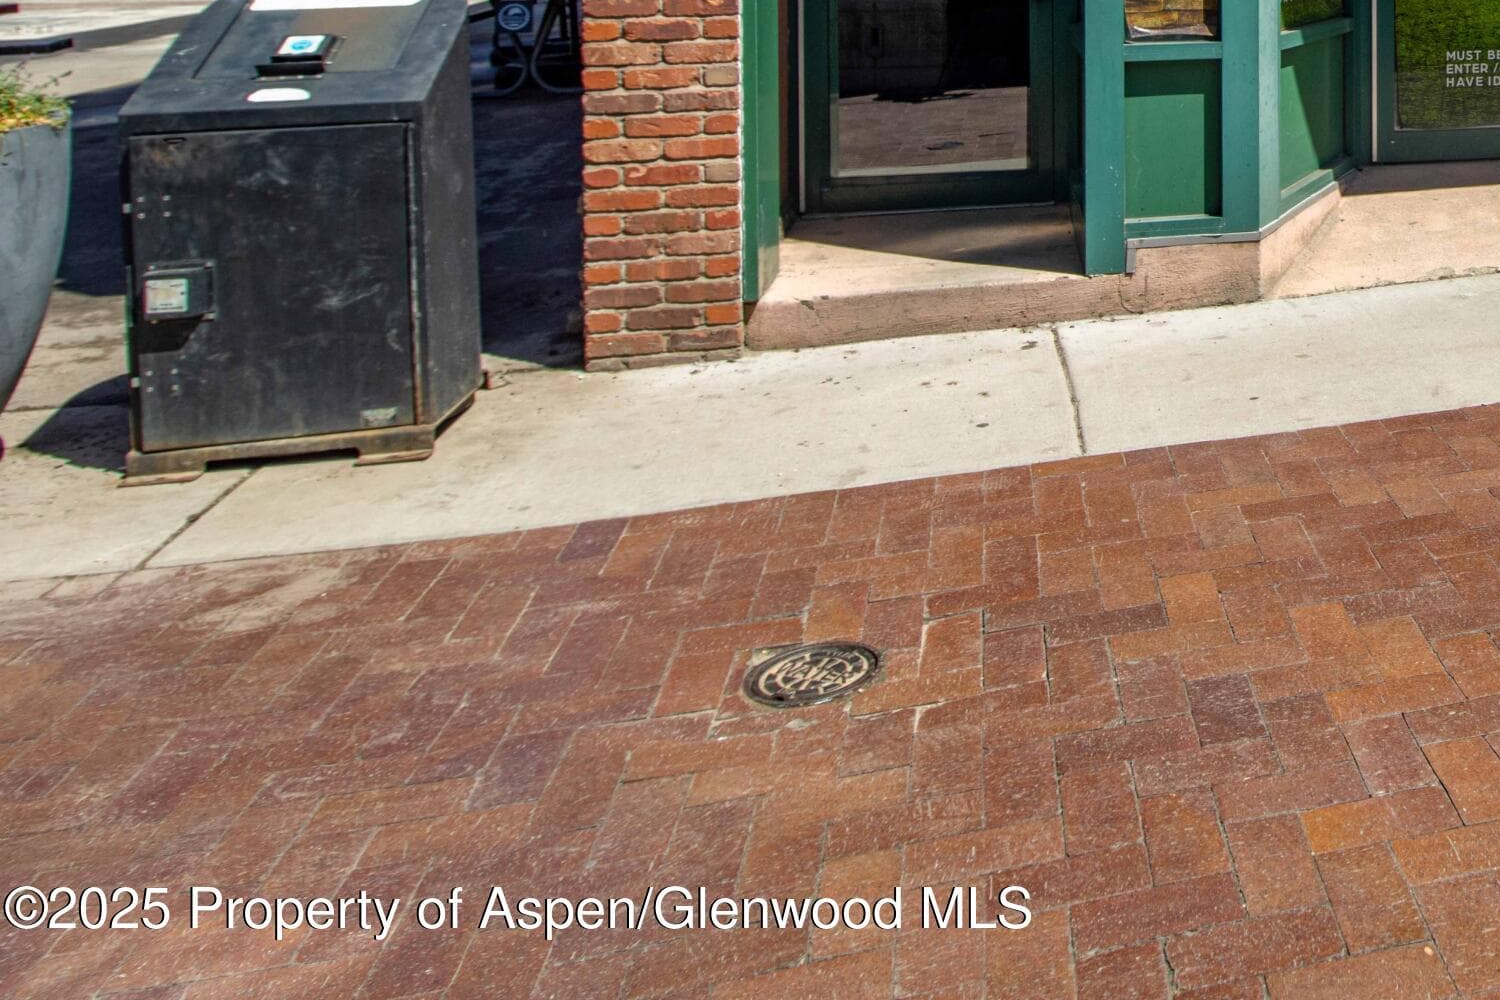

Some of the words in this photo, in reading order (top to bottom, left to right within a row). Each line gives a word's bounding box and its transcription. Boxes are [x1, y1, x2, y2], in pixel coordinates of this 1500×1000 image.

[1446, 49, 1482, 61] MUST
[1446, 63, 1489, 75] ENTER
[1446, 76, 1484, 88] HAVE
